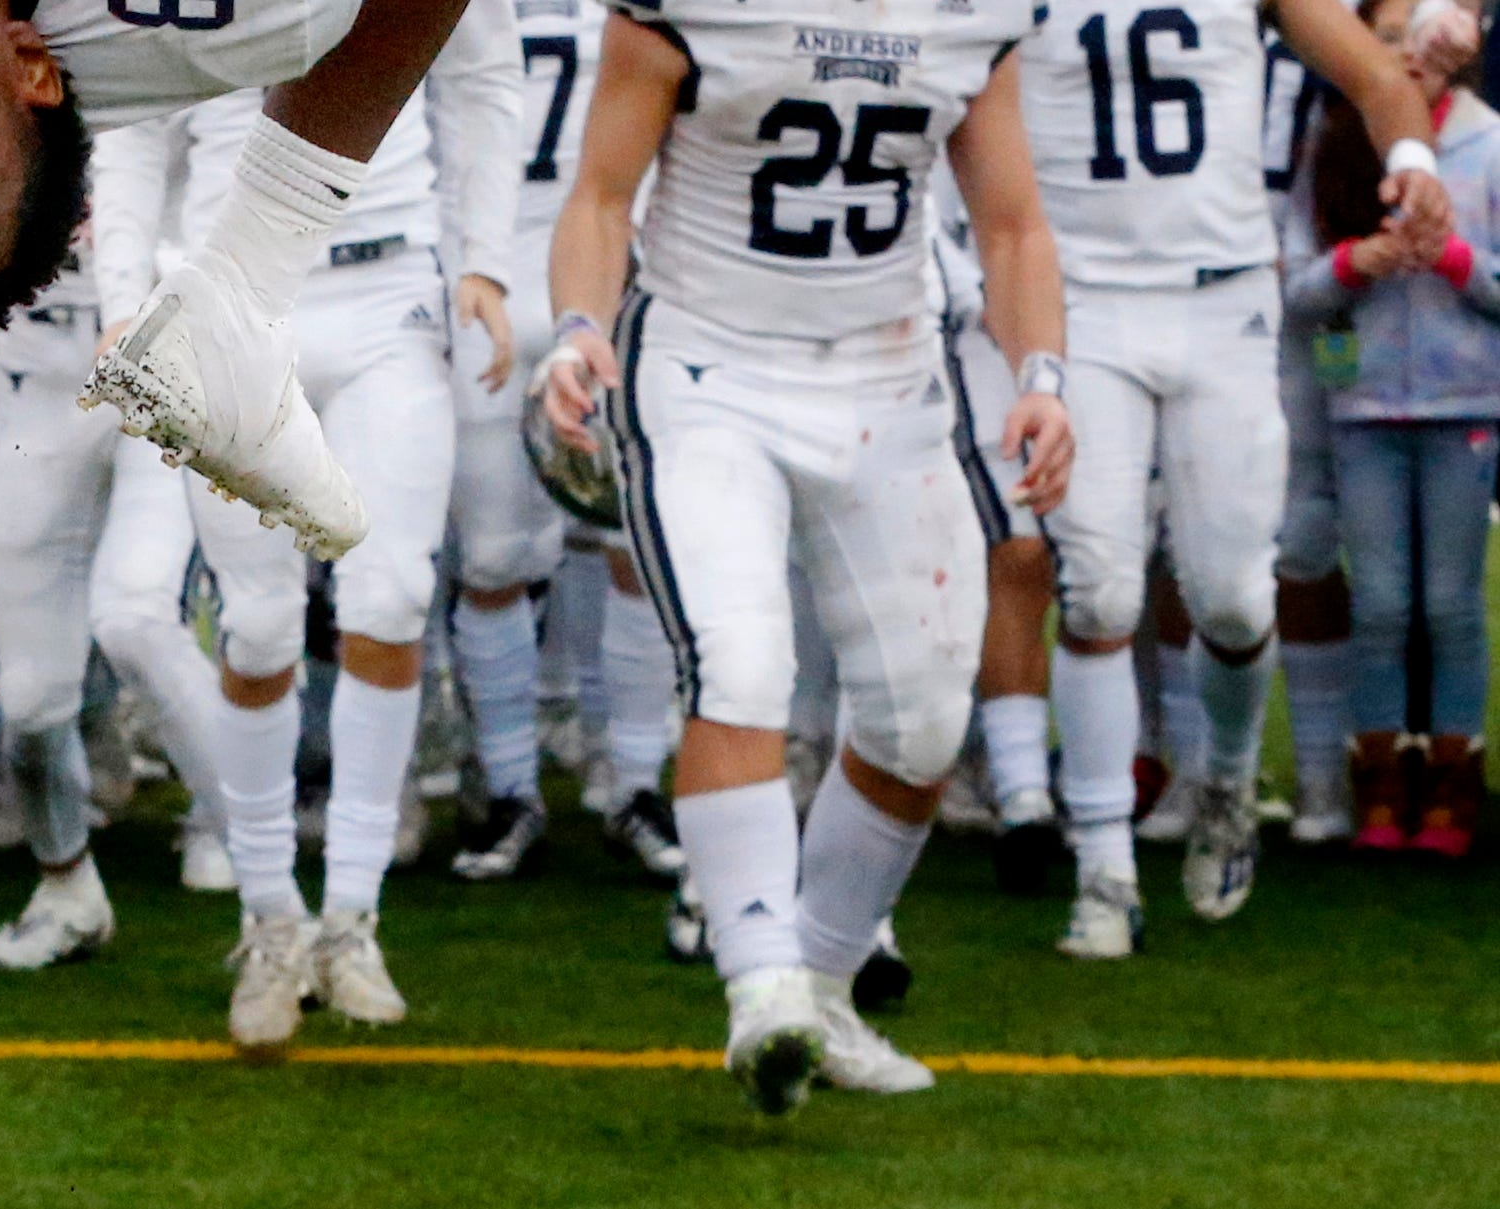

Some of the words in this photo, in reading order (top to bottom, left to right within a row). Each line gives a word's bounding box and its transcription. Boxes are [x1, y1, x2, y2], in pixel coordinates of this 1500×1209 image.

[520, 35, 579, 182] 7
[795, 29, 922, 60] ANDERSON
[1077, 7, 1207, 181] 16
[748, 97, 934, 259] 25
